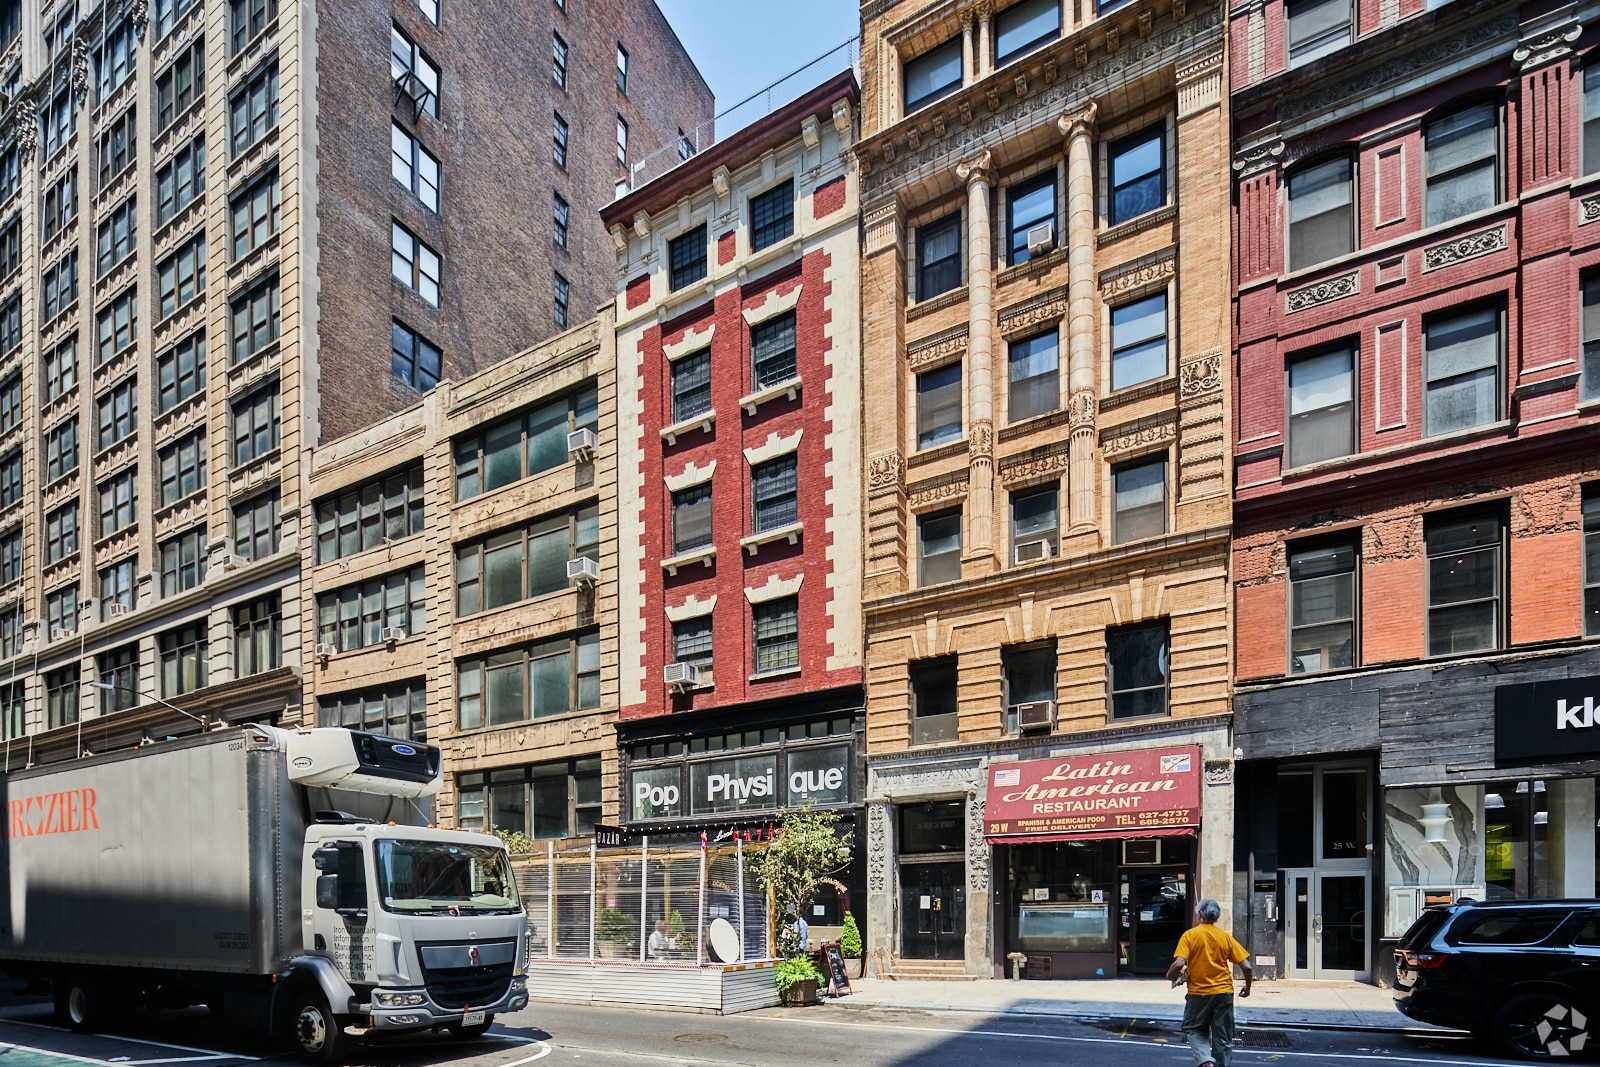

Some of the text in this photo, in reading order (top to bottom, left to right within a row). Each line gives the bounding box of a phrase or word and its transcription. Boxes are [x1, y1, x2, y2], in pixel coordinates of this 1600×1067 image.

[228, 742, 243, 751] 12034
[1041, 760, 1134, 782] Latin
[635, 782, 679, 811] Pop
[707, 767, 773, 804] Physi
[1002, 778, 1178, 803] American
[1032, 796, 1142, 815] RESTAURANT
[1017, 819, 1045, 827] SPANISH
[1051, 817, 1087, 826] AMERICAN
[1087, 815, 1106, 823] FOOD
[1115, 809, 1190, 826] TEL: 627-4737
[1139, 817, 1189, 826] 689-2570
[990, 822, 1009, 834] 29 W
[1050, 823, 1097, 831] DELIVERY
[1332, 842, 1343, 850] 25
[1094, 892, 1101, 900] A
[333, 925, 376, 934] Iron Mountain
[333, 934, 370, 943] Information
[334, 943, 375, 953] Management
